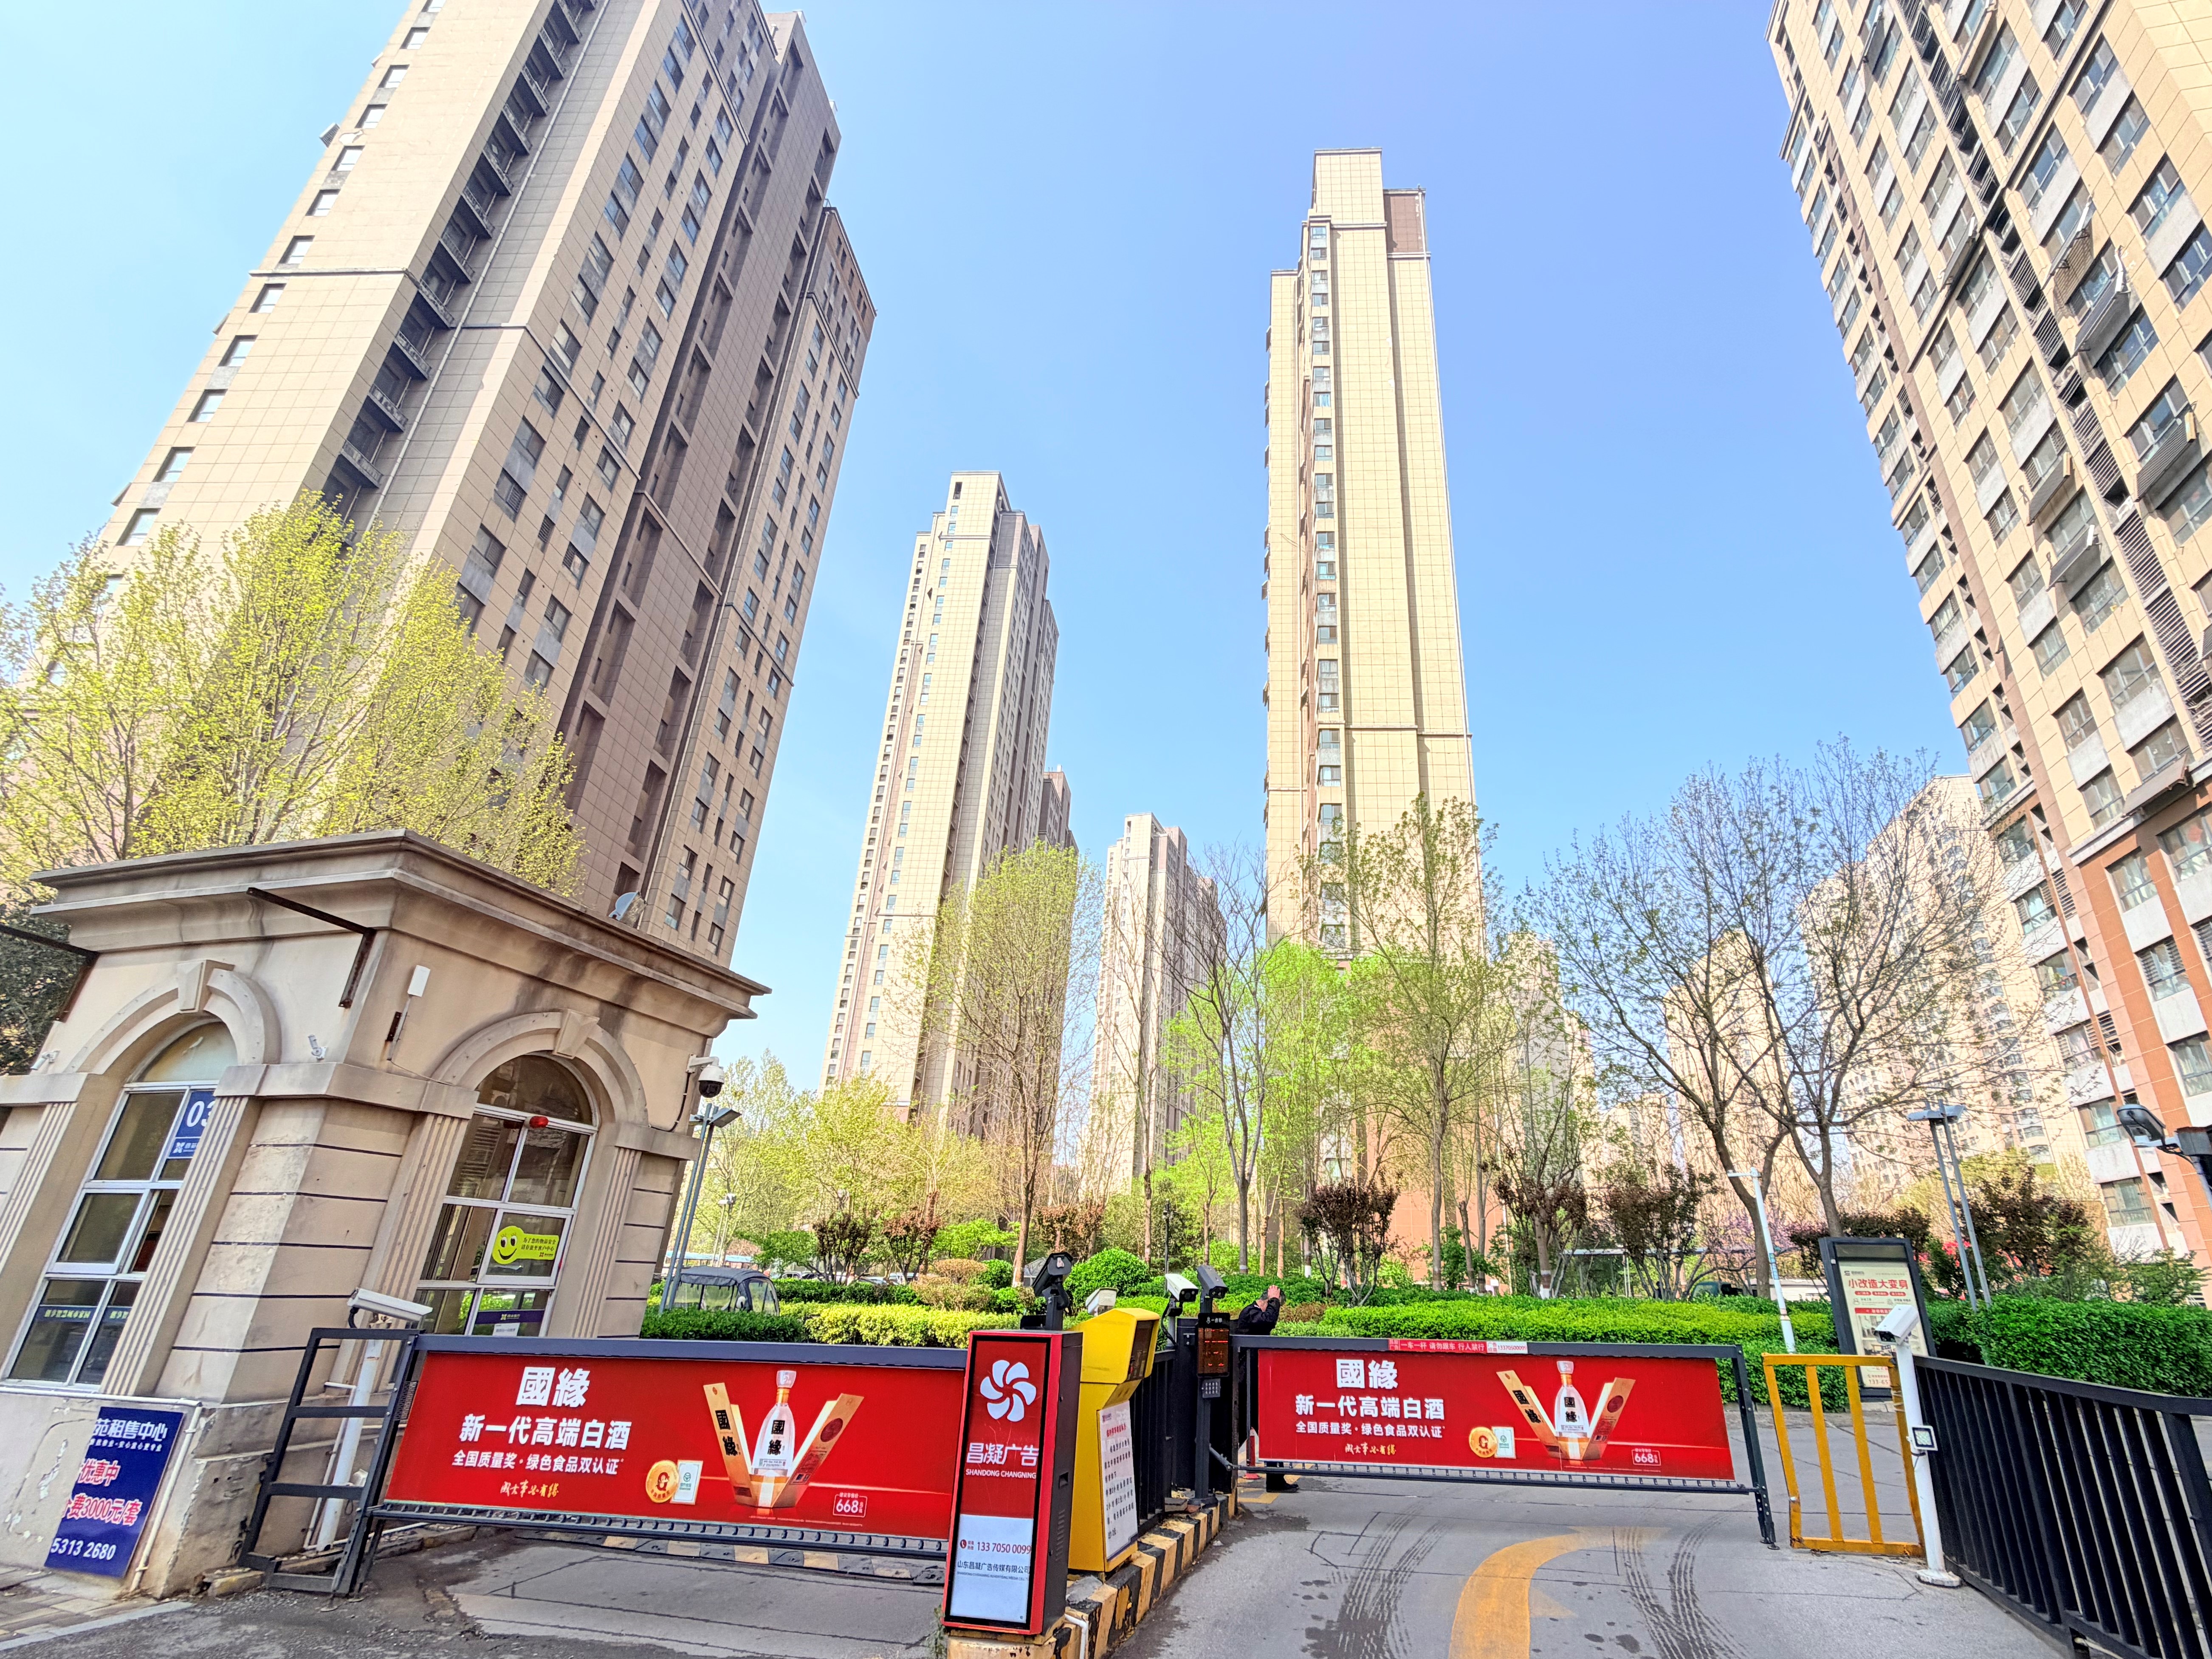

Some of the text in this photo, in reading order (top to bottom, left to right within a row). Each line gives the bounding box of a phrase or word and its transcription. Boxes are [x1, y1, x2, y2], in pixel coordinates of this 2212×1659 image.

[1848, 1279, 1908, 1289] 小改造大变身
[1401, 1342, 1484, 1351] 一车一杆 请勿跟车 行人禁行
[1336, 1359, 1398, 1389] 國緣
[515, 1366, 590, 1407] 國緣
[1295, 1394, 1445, 1420] 新一代高端白酒
[459, 1413, 632, 1450] 新一代高端白酒
[966, 1442, 1039, 1466] 昌凝广告
[1634, 1453, 1654, 1463] 668
[77, 1458, 121, 1487] 优惠中
[966, 1469, 1036, 1479] SHANDONG CHANGNING
[836, 1499, 858, 1513] 668
[51, 1538, 117, 1560] 5313 2680
[977, 1542, 990, 1552] 133
[992, 1543, 1010, 1553] 7050
[1012, 1544, 1031, 1554] 0099
[957, 1560, 1030, 1574] 山东昌凝广告传媒有限公司
